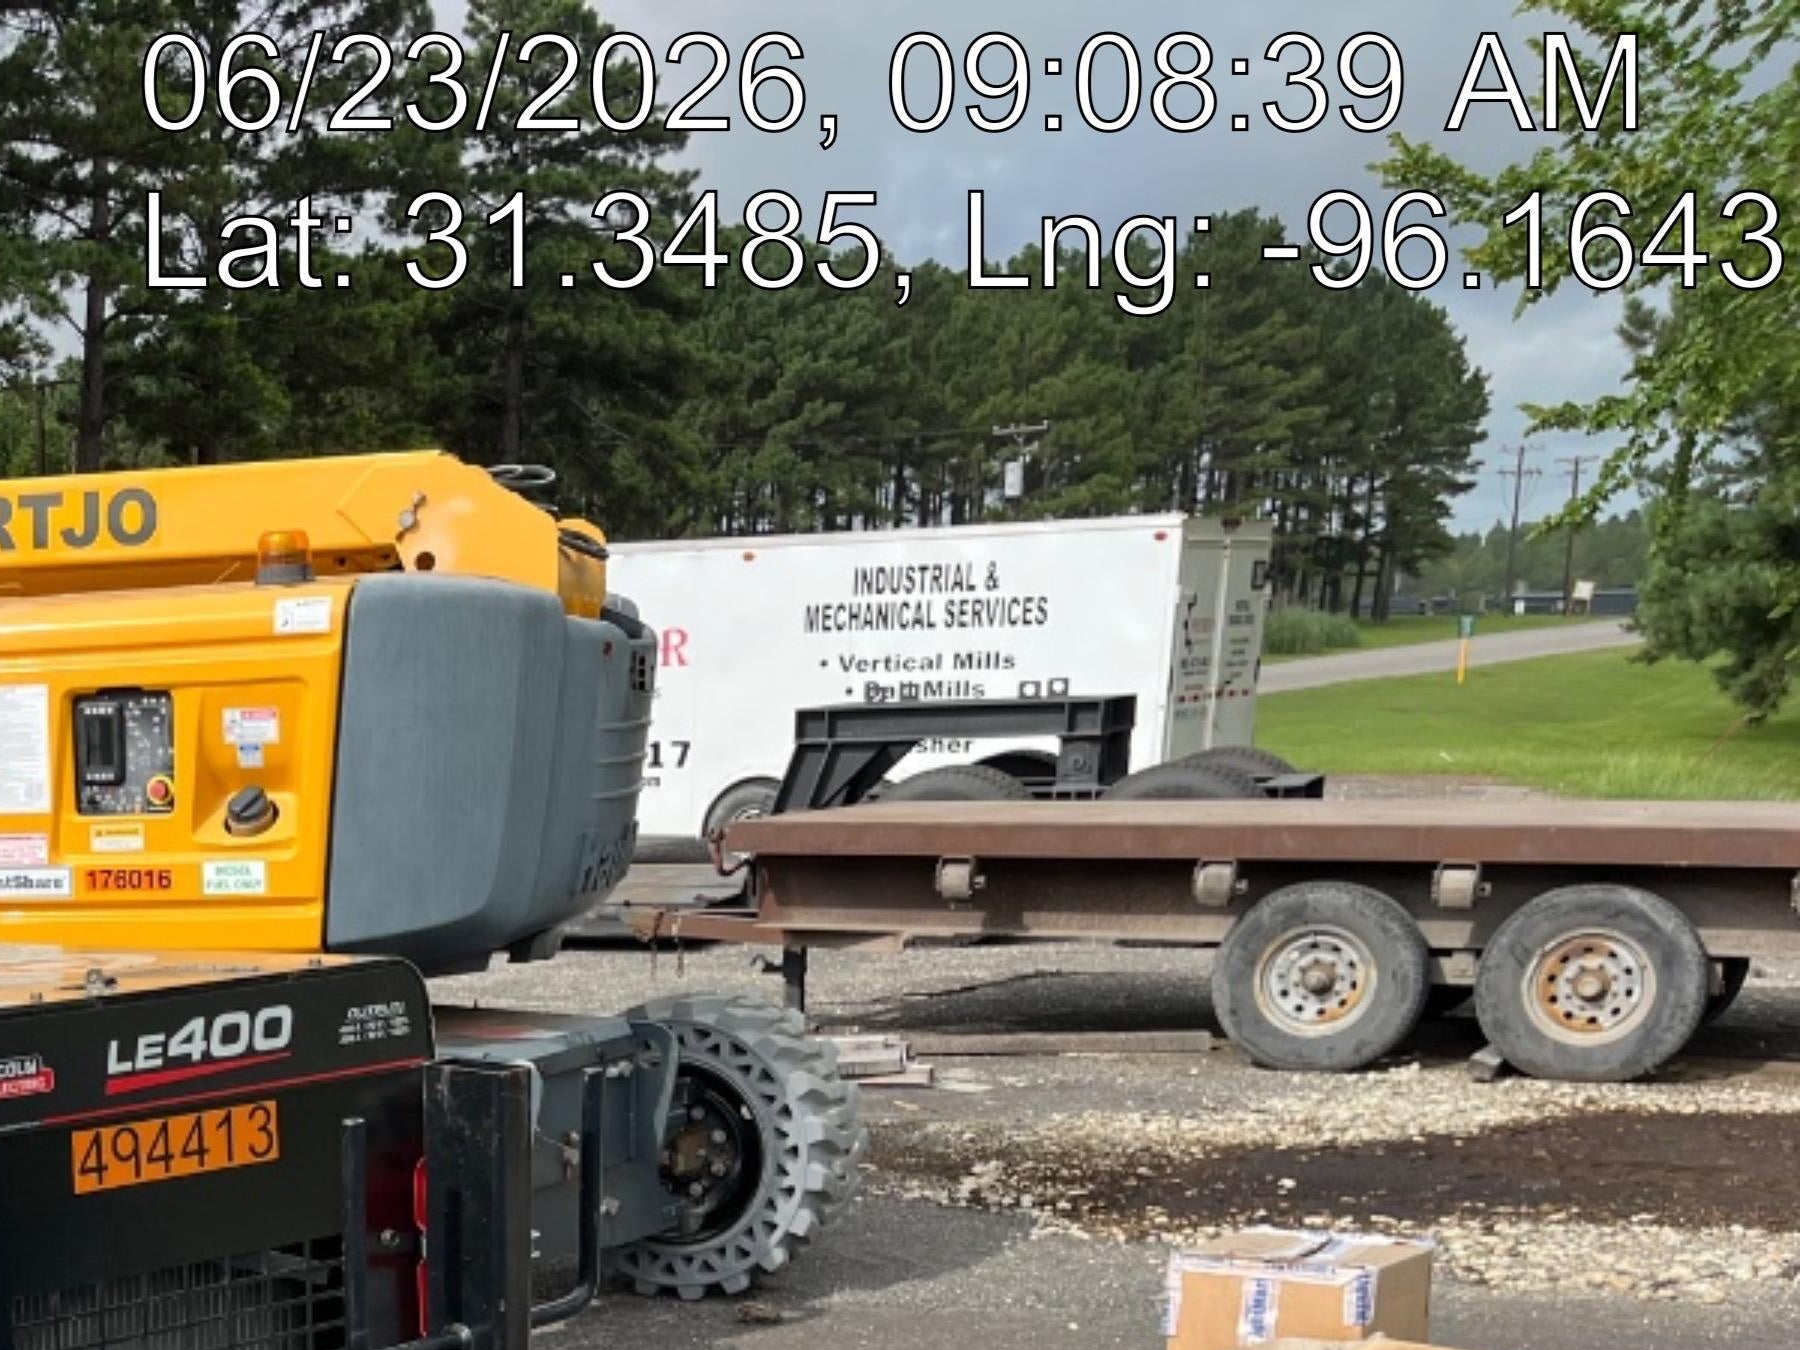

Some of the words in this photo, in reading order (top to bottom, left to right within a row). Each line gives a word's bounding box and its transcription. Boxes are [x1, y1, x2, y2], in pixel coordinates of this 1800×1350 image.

[852, 563, 976, 596] INDUSTRIAL
[985, 560, 1000, 592] &
[803, 600, 937, 633] MECHANICAL
[944, 596, 1049, 628] SERVICES
[838, 653, 943, 673] Vertical
[953, 651, 1016, 671] Mills
[923, 679, 986, 698] Mills
[86, 868, 172, 890] 176016
[106, 1004, 294, 1076] LE400
[78, 1102, 276, 1186] 494413
